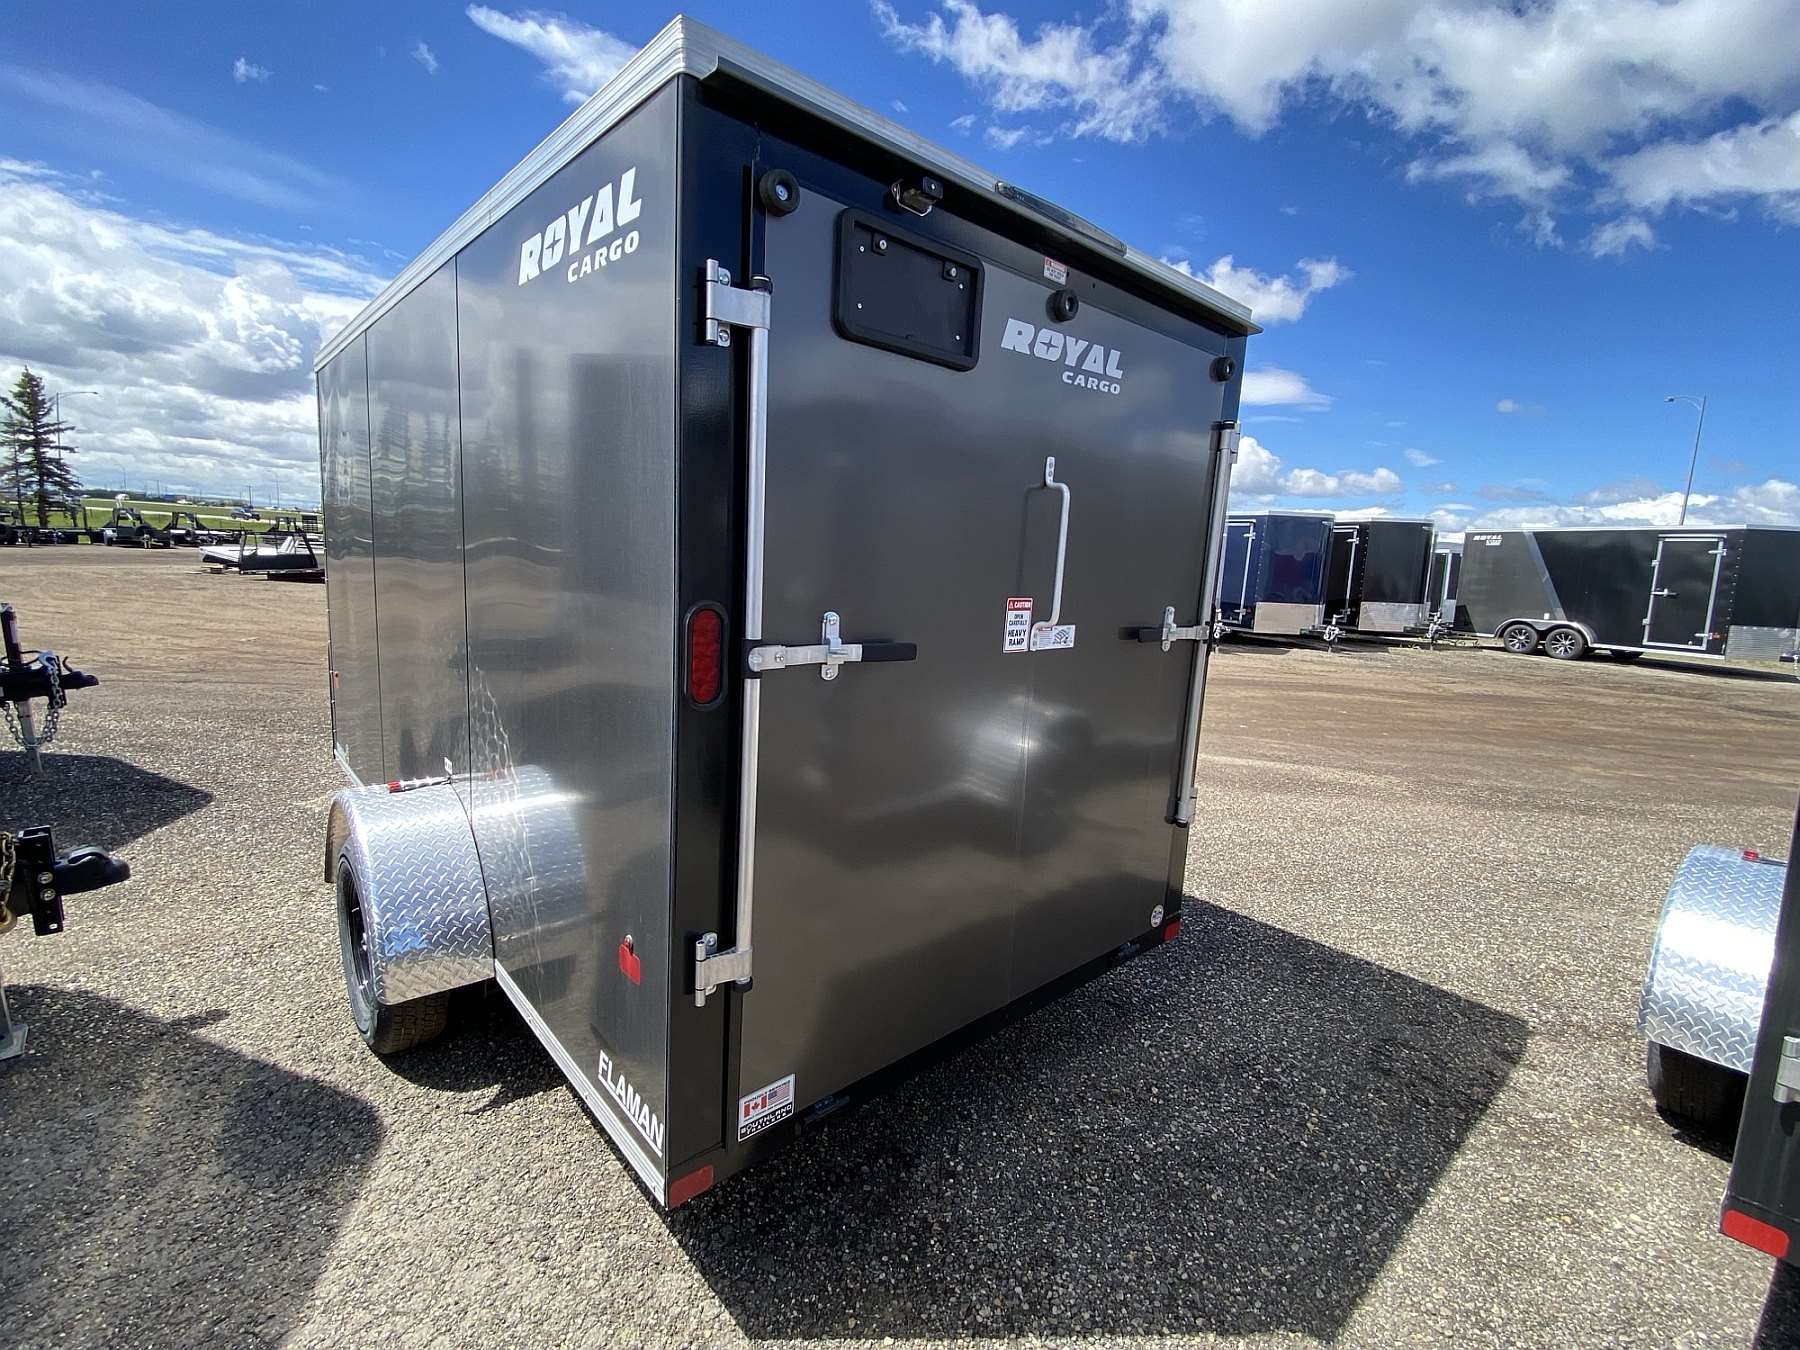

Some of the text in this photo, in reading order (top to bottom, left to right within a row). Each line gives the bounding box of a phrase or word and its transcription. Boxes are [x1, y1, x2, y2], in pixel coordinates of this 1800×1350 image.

[518, 167, 642, 286] ROYAL
[567, 230, 640, 284] CARGO
[1000, 318, 1123, 379] ROYAL
[1062, 371, 1121, 395] CARGO
[1014, 601, 1031, 609] CAUTION
[1007, 629, 1027, 638] HEAVY
[1008, 638, 1025, 647] RAMP
[598, 1050, 664, 1150] FLAMAN
[740, 1104, 792, 1134] SOUTHLAND
